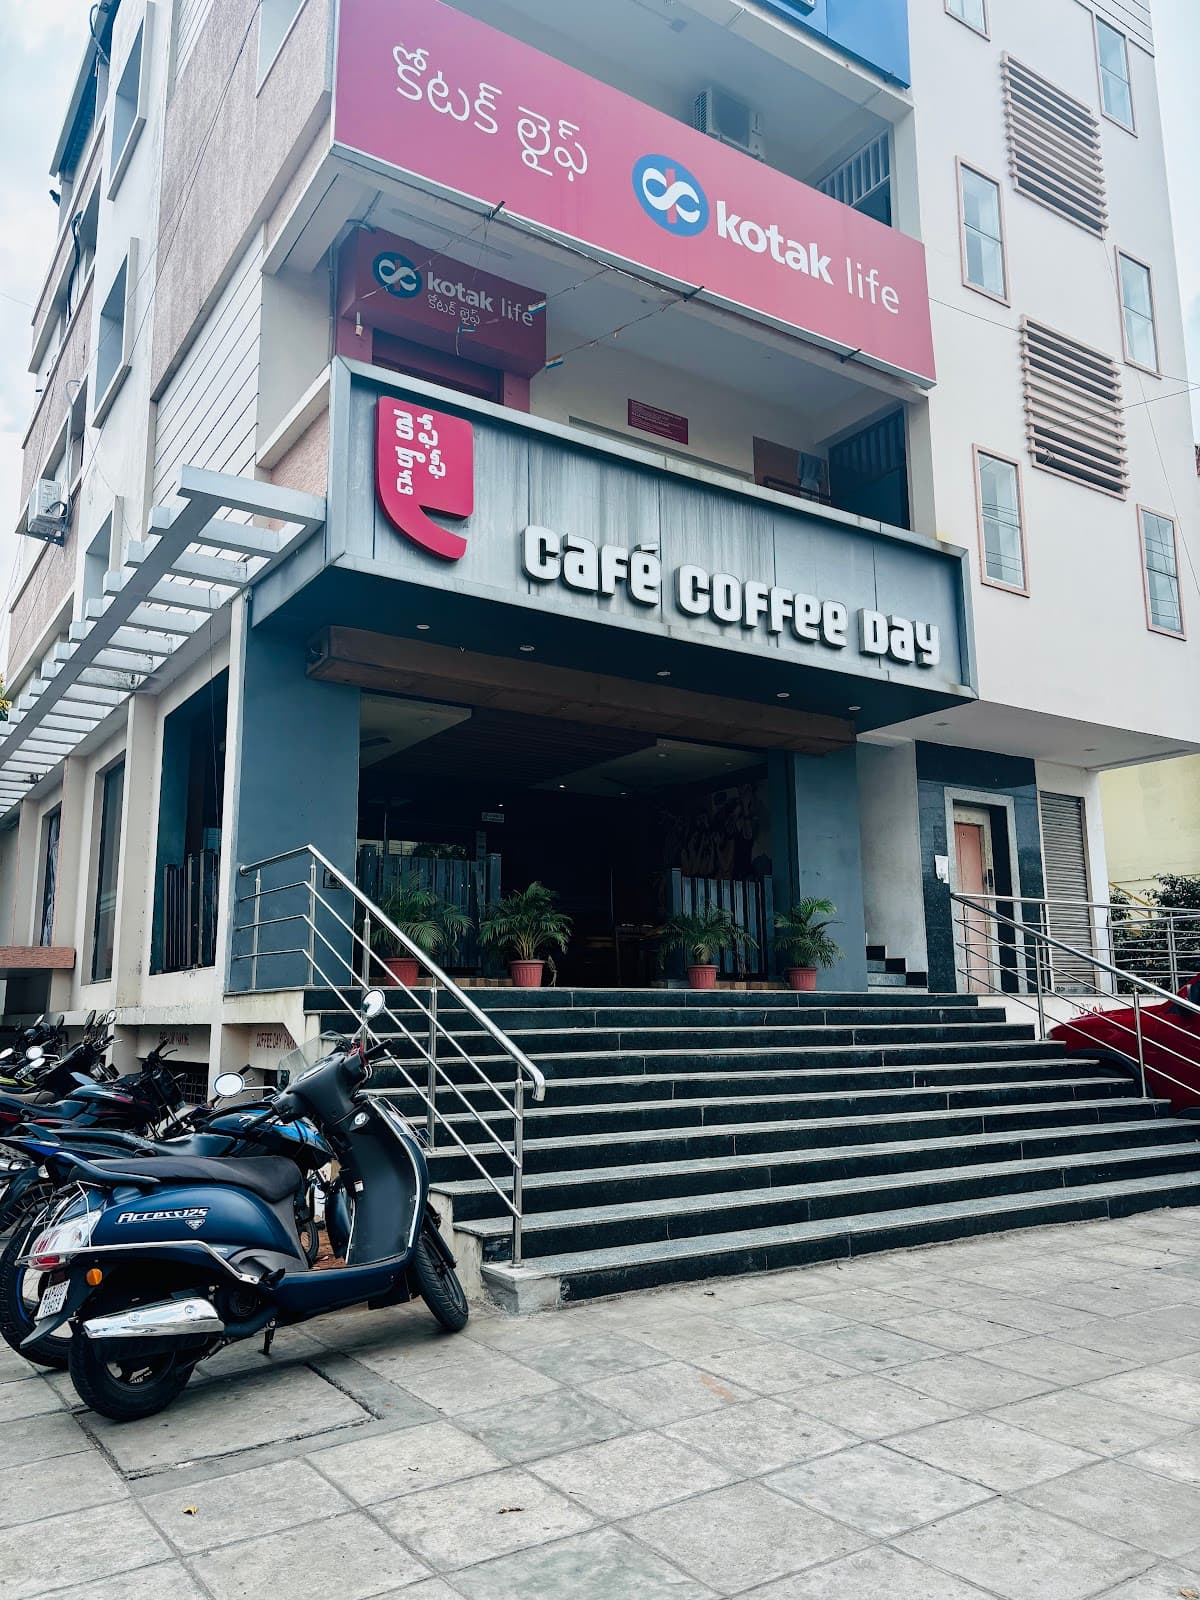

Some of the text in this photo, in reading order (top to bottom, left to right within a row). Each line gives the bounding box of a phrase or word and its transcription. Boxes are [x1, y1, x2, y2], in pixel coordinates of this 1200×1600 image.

[392, 43, 589, 182] కోటక్ లైఫ్
[427, 272, 533, 326] kotak life
[716, 199, 900, 316] kotak life
[857, 607, 940, 667] Day
